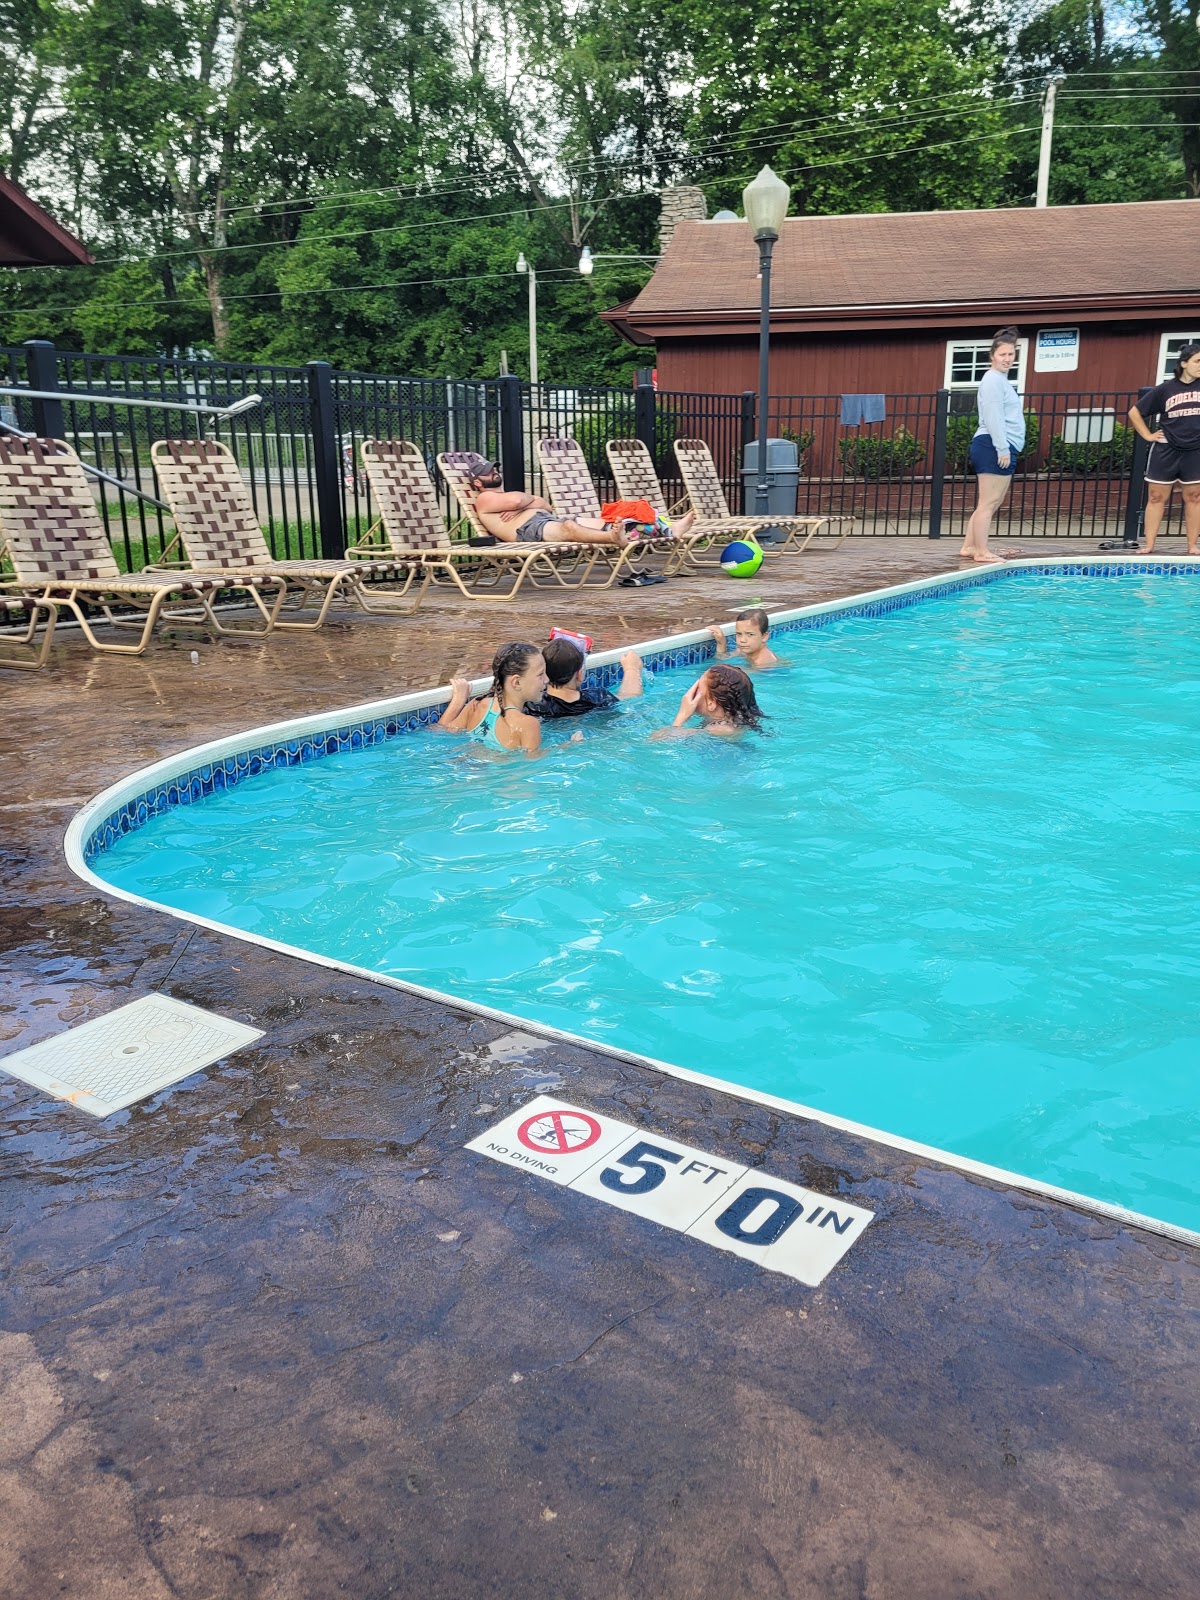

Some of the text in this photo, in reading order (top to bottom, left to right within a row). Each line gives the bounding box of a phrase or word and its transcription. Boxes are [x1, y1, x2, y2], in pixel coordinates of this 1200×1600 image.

[486, 1143, 559, 1175] NO DIVING
[600, 1141, 855, 1246] 5 FT 0 IN
